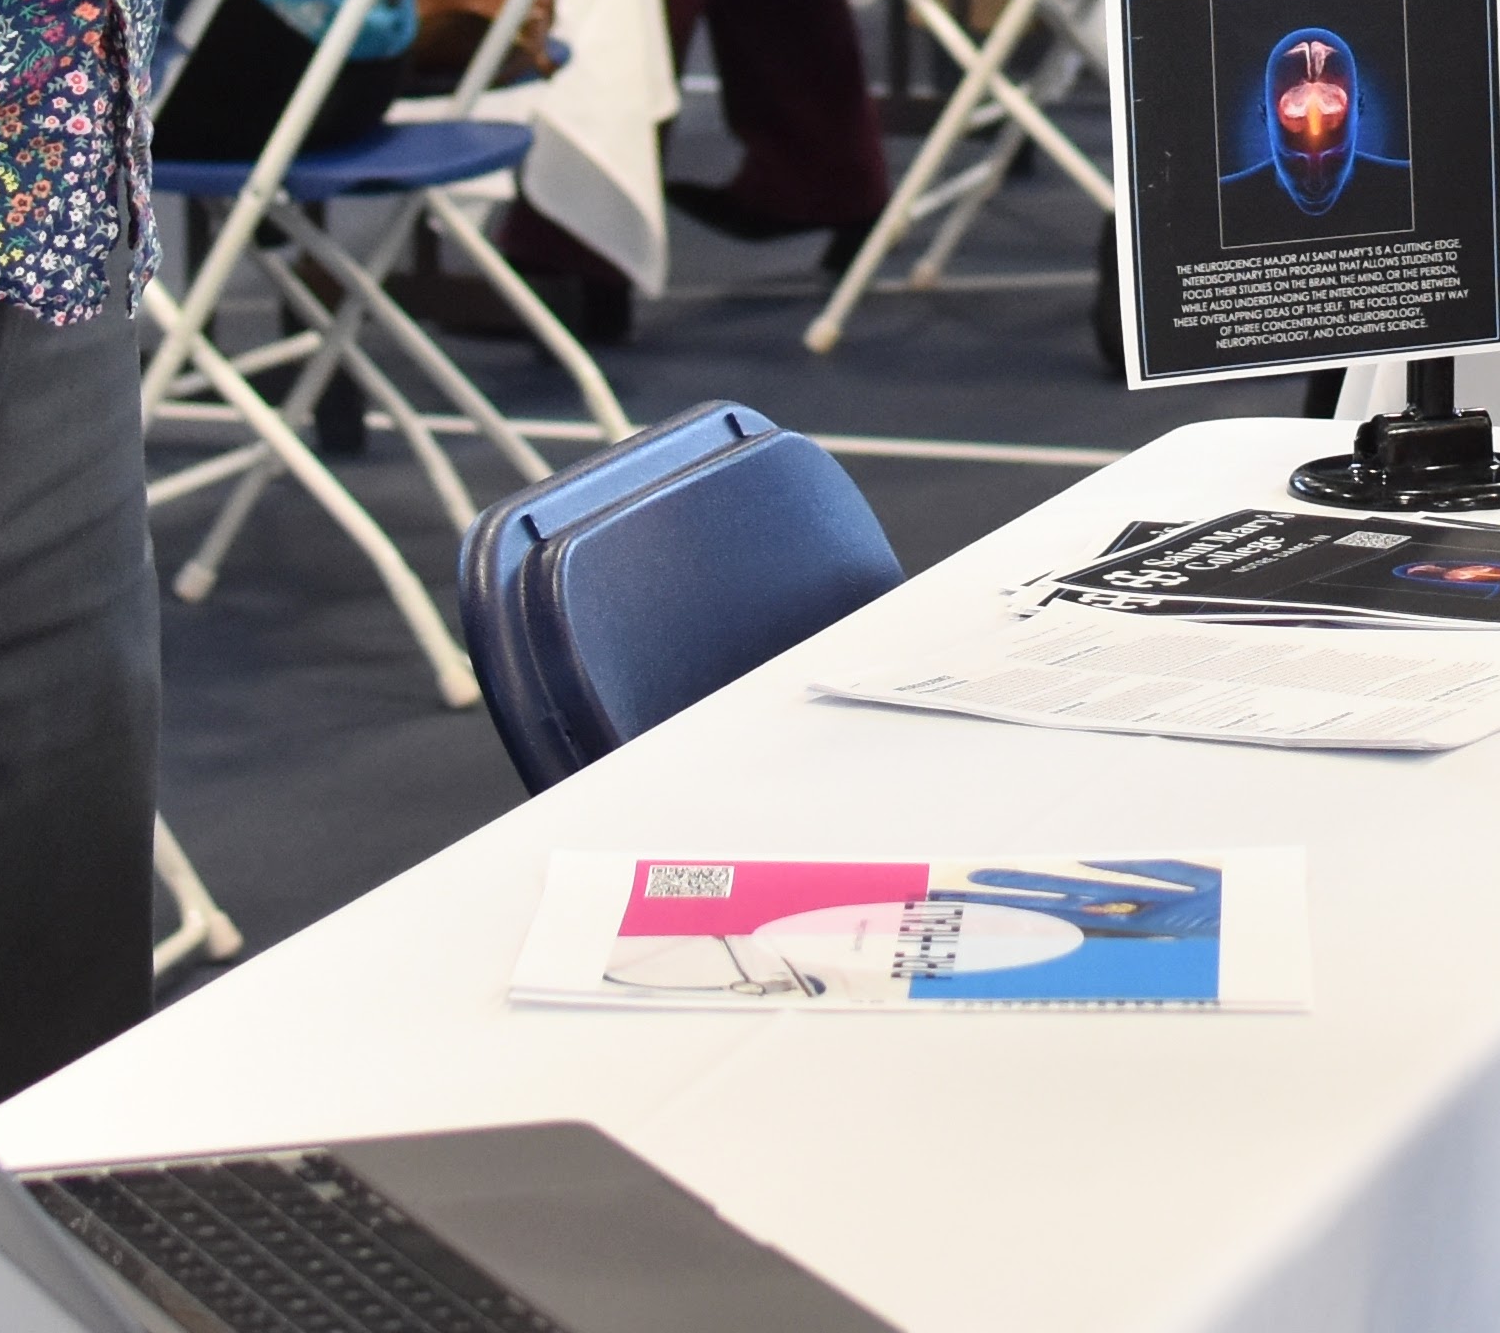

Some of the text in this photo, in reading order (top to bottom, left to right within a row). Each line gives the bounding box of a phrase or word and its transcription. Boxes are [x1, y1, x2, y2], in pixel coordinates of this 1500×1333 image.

[1176, 265, 1192, 275] THE
[1194, 258, 1262, 273] NEUROSCIENCE
[1263, 254, 1297, 267] MAJOR
[1299, 253, 1310, 263] AT
[1312, 250, 1337, 262] SAINT
[1339, 247, 1373, 259] MARY'S
[1375, 246, 1382, 256] IS
[1384, 245, 1392, 255] A
[1182, 251, 1458, 287] INTERDISCIPLINARY STEM PROGRAM THAT ALLOWS STUDENTS TO
[1181, 277, 1460, 314] WHILE ALSO UNDERSTANDING THE INTERCONNECTIONS BETWEEN
[1183, 288, 1213, 300] FOCUS
[1215, 286, 1237, 297] THEIR
[1239, 282, 1272, 295] STUDIES
[1274, 281, 1289, 291] ON
[1291, 279, 1307, 289] THE
[1340, 274, 1356, 285] THE
[1386, 270, 1400, 280] OR
[1402, 268, 1418, 279] THE
[1173, 316, 1198, 327] THESE
[1200, 310, 1262, 325] OVERLAPPING
[1264, 307, 1289, 319] IDEAS
[1291, 306, 1305, 316] OF
[1306, 304, 1322, 314] THE
[1349, 300, 1365, 310] THE
[1367, 297, 1397, 309] FOCUS
[1400, 293, 1433, 305] COMES
[1435, 292, 1445, 302] BY
[1448, 290, 1469, 301] WAY
[1220, 326, 1232, 336] OF
[1234, 323, 1260, 335] THREE
[1313, 328, 1334, 339] AND
[1336, 324, 1385, 337] COGNITIVE
[1143, 542, 1223, 567] Saint
[1200, 513, 1296, 544] Mary's
[1184, 536, 1285, 570] College
